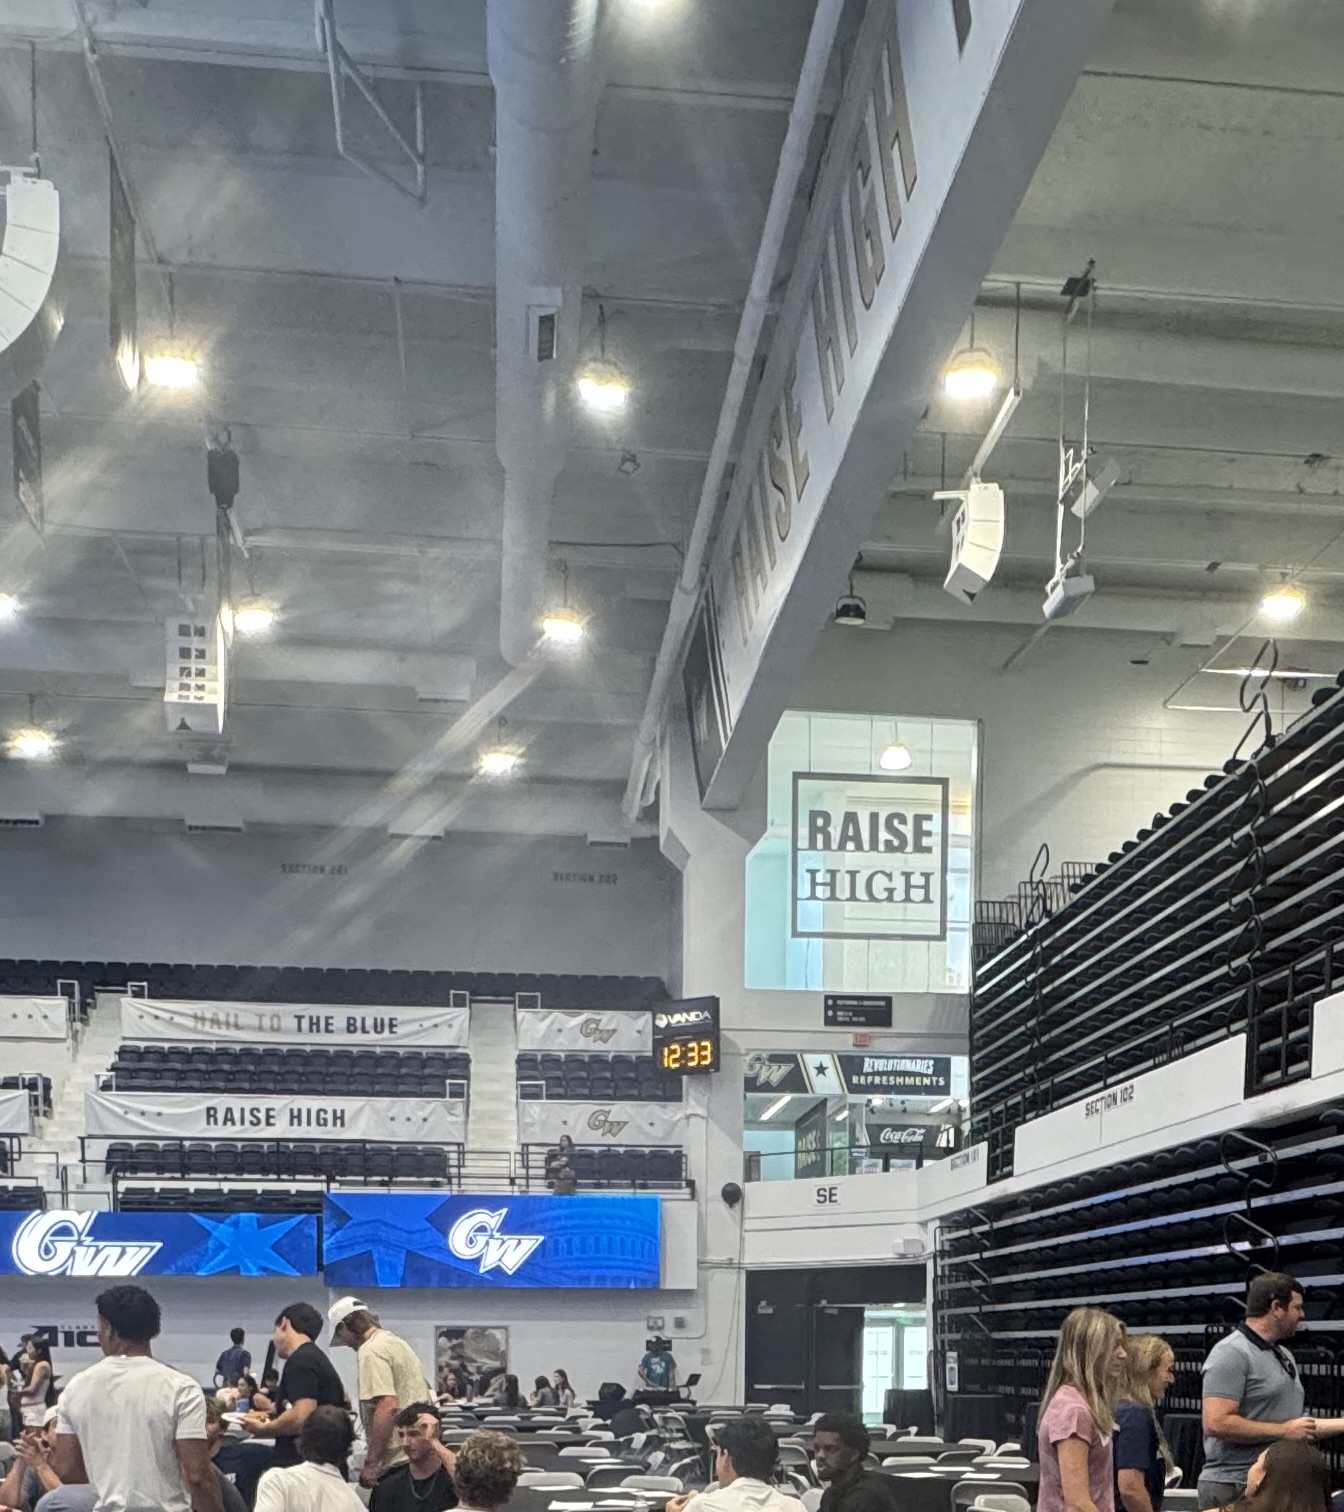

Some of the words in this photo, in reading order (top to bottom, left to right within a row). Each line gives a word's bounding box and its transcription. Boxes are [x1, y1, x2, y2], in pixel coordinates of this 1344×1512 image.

[808, 809, 934, 854] RAISE
[805, 868, 935, 904] HIGH
[192, 1011, 242, 1032] HAIL
[255, 1012, 283, 1033] TO
[293, 1014, 335, 1035] THE
[345, 1016, 399, 1035] BLUE
[668, 1009, 712, 1026] VANDA
[662, 1039, 714, 1069] 12:33
[851, 1074, 946, 1087] REFRESHMENTS
[1084, 1091, 1118, 1118] SECTION
[1119, 1084, 1136, 1104] 102
[205, 1106, 277, 1128] RAISE
[288, 1107, 347, 1129] HIGH
[815, 1186, 839, 1205] SE
[447, 1206, 546, 1276] GW
